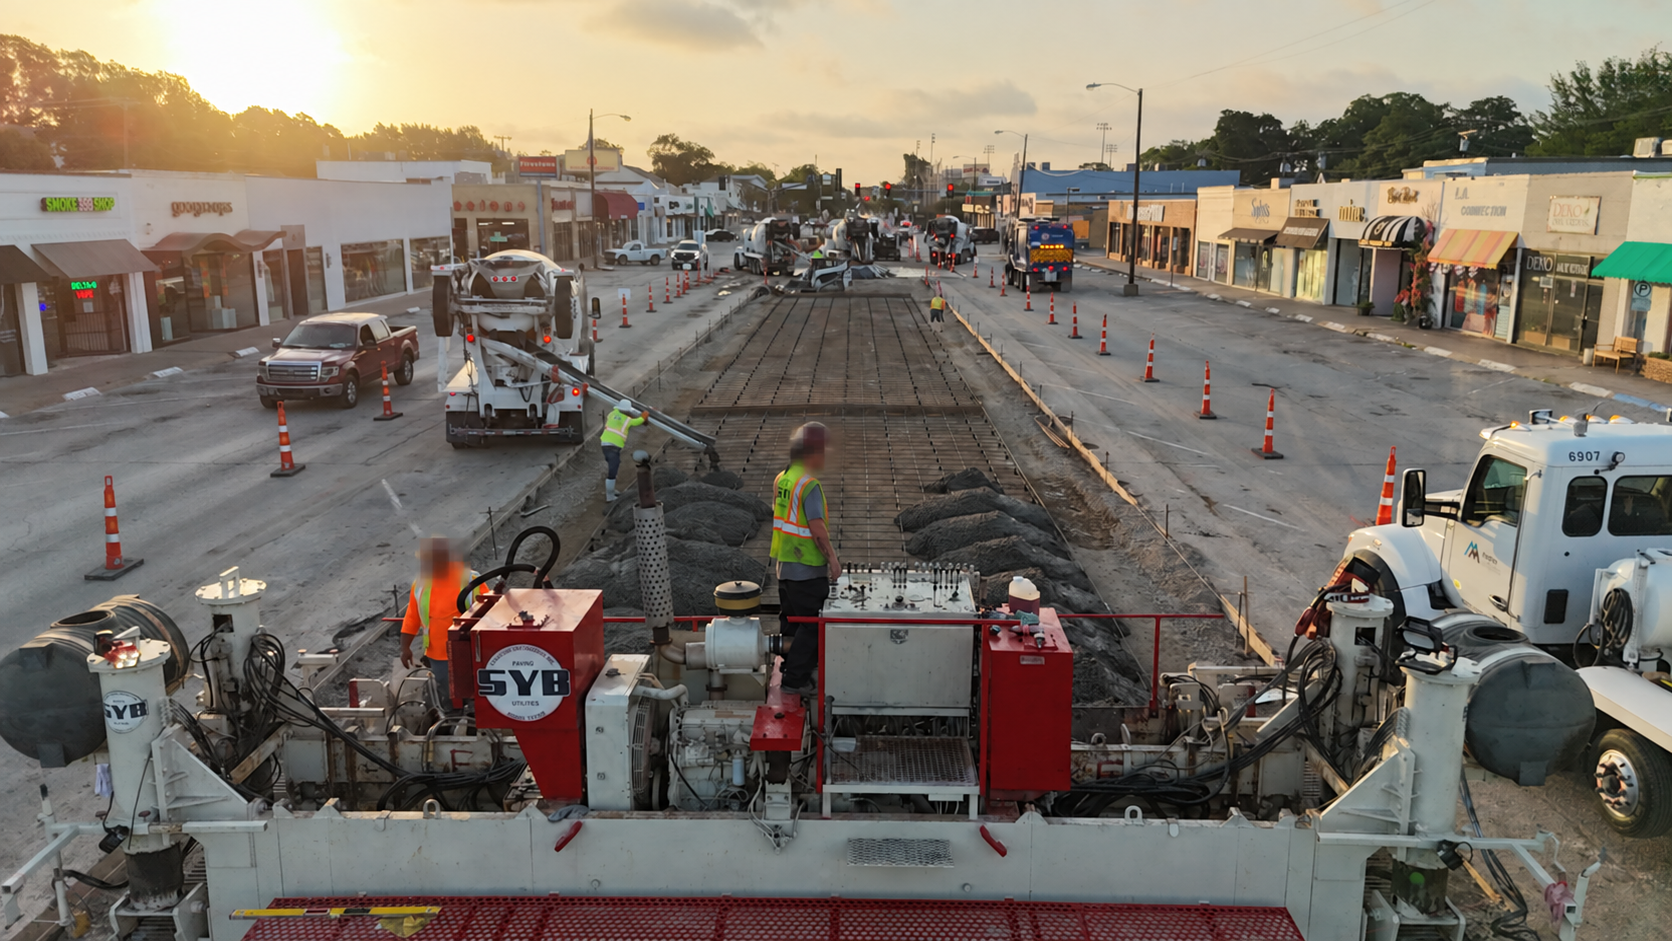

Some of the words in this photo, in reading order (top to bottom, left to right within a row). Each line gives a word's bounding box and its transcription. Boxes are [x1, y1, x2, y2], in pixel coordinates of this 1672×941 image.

[46, 197, 77, 212] SMOKE
[93, 197, 115, 211] SHOP
[1568, 451, 1600, 462] 6907
[477, 669, 570, 697] SYB
